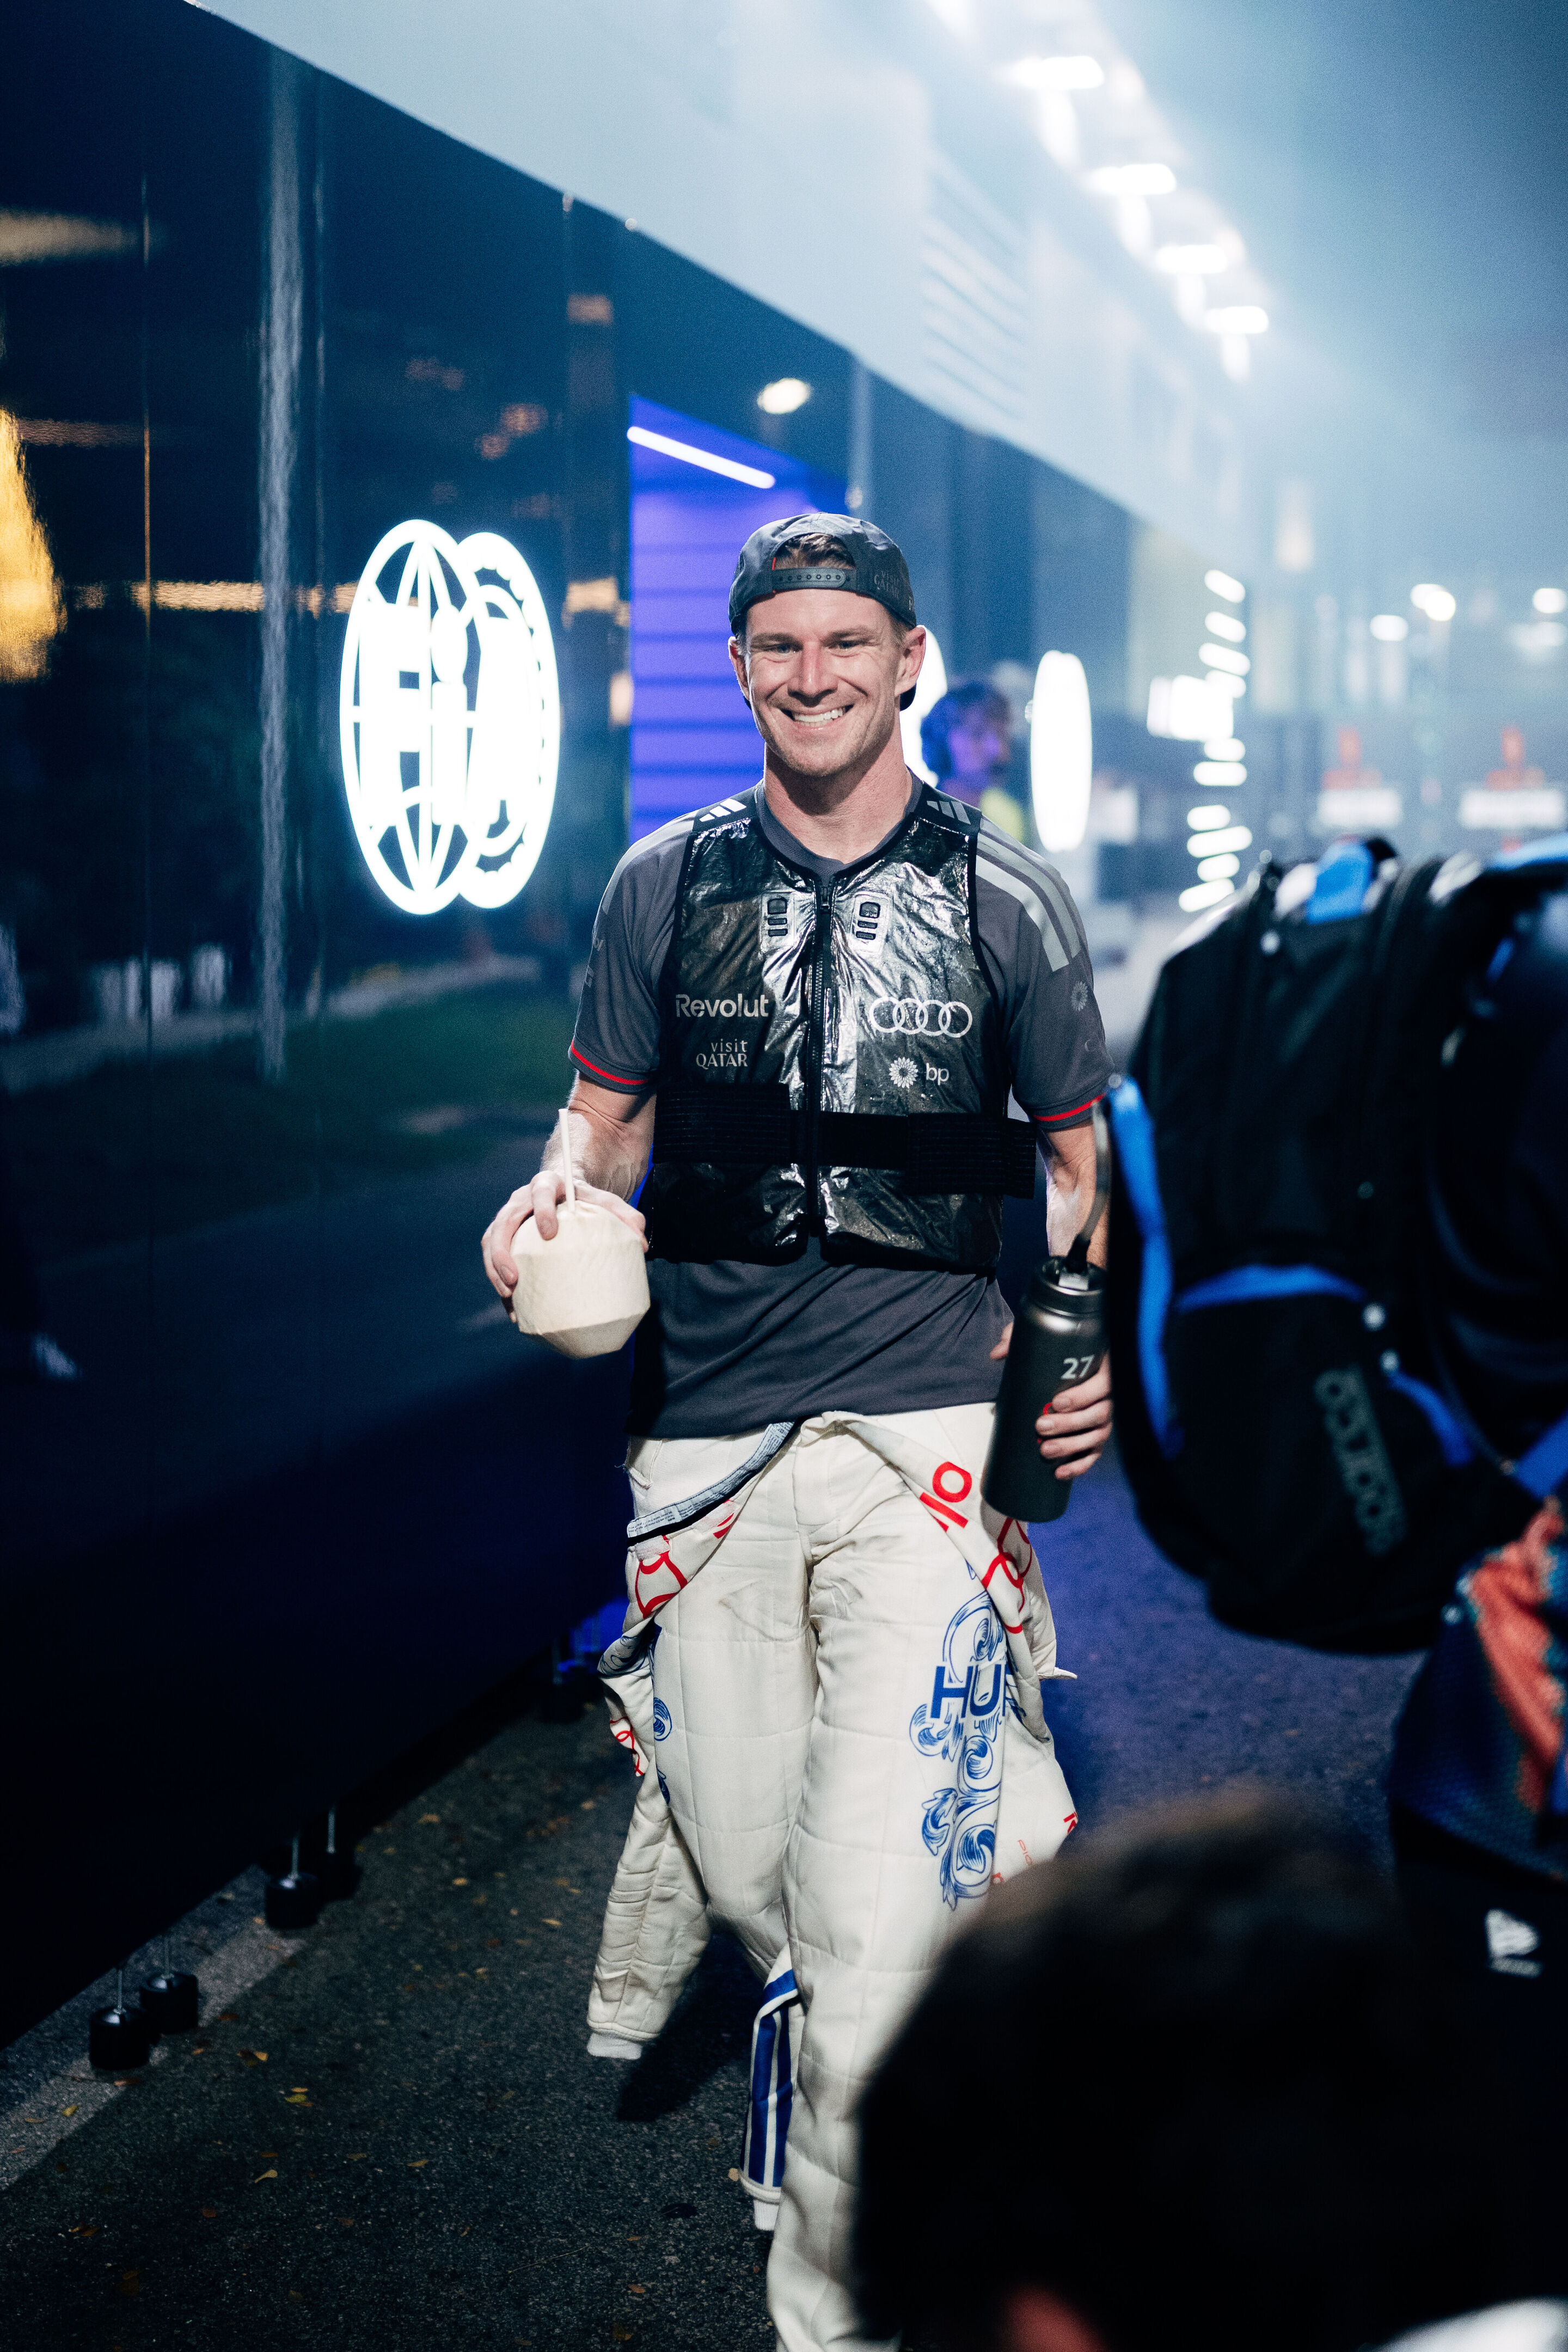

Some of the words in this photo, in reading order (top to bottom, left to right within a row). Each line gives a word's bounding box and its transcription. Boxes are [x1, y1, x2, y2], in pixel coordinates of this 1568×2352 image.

[676, 994, 769, 1018] Revolut
[710, 1038, 748, 1052] visit
[696, 1053, 748, 1070] QATAR
[926, 1062, 950, 1086] bp
[1061, 1354, 1095, 1380] 27
[930, 1664, 1007, 1719] HU
